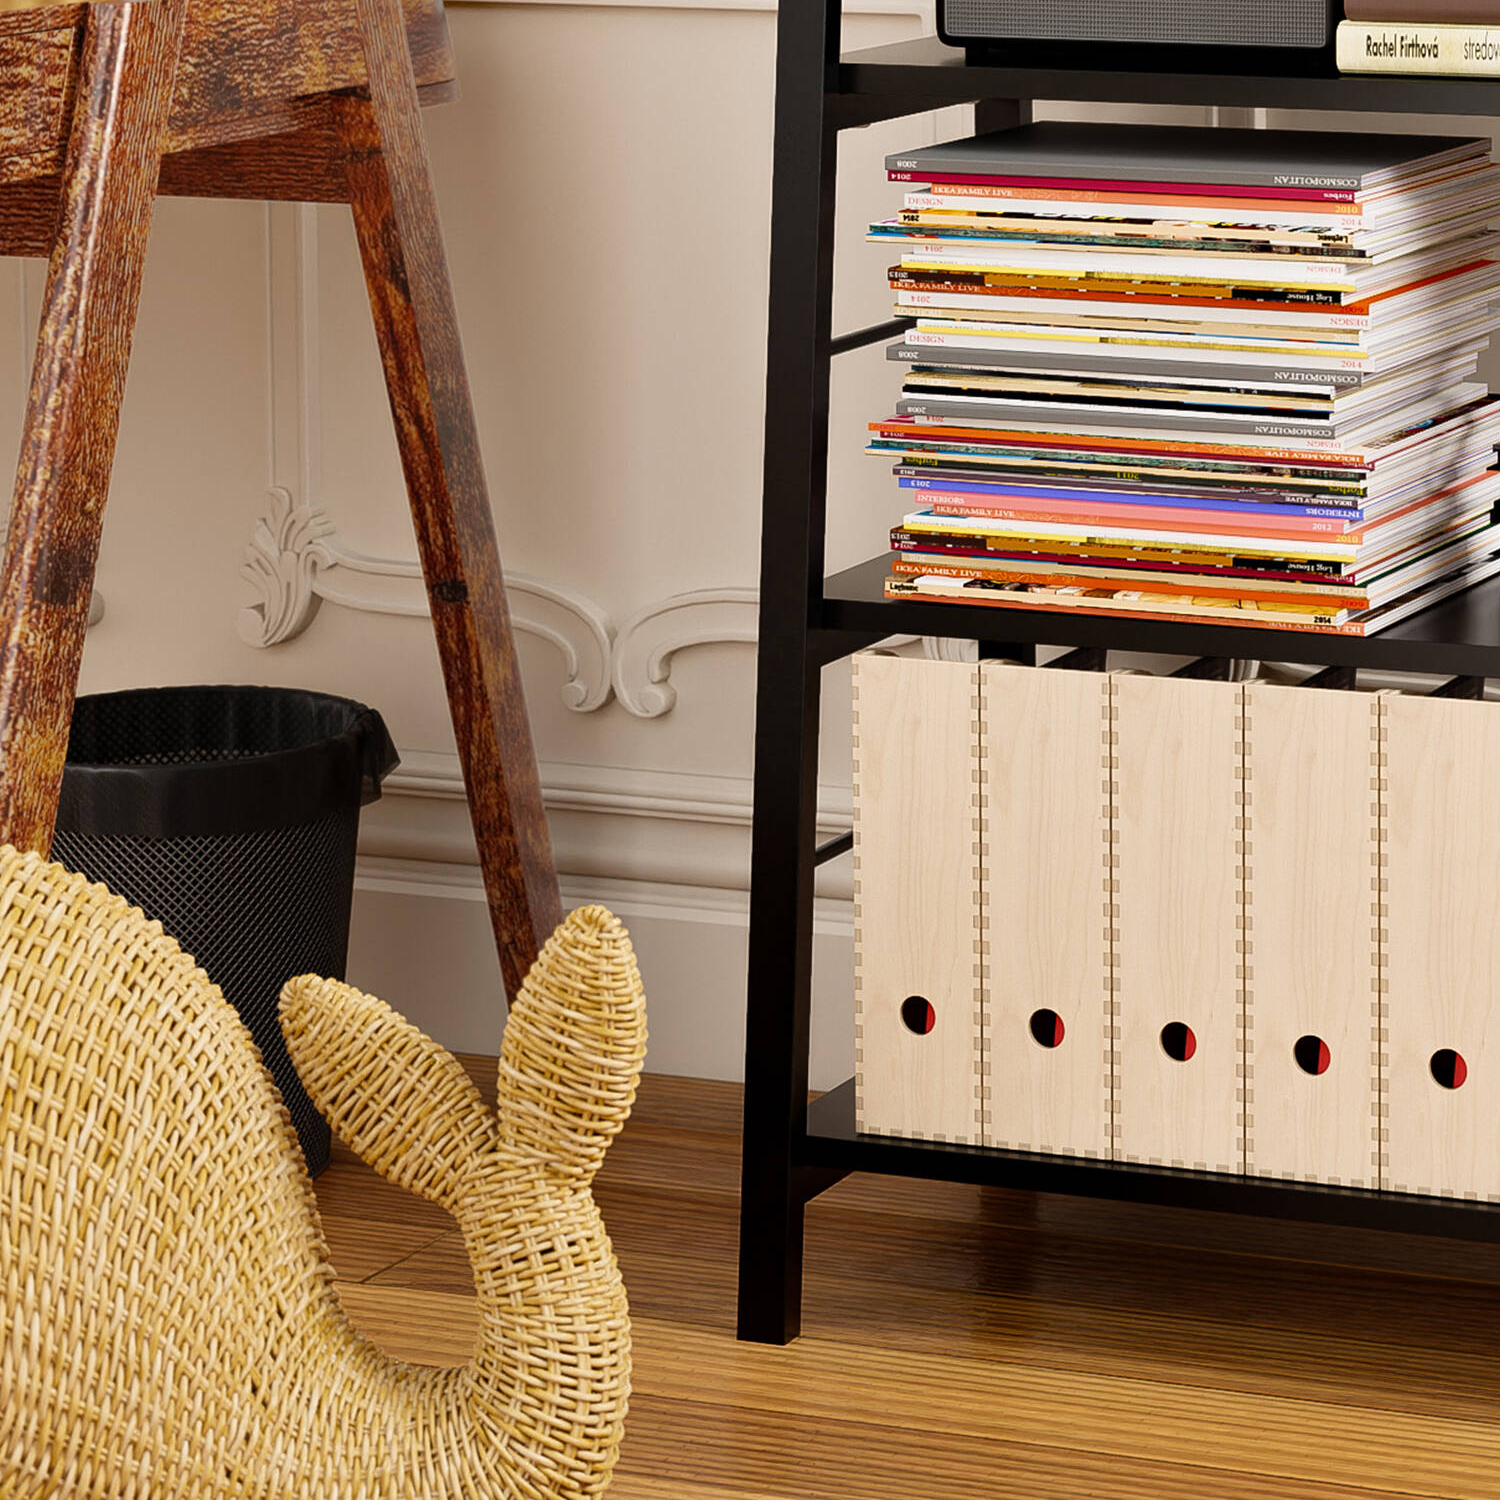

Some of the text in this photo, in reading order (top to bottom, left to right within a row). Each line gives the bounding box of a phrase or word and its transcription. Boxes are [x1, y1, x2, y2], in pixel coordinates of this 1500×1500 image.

[1366, 34, 1438, 59] Rachel Firthová
[896, 160, 918, 169] 2008
[891, 173, 912, 181] 2014
[1274, 176, 1358, 187] COSMOPOLITAN
[934, 186, 1013, 197] IKEA FAMILY LIVE
[1323, 192, 1354, 201] Forbes
[908, 197, 944, 206] DESIGN
[1335, 205, 1358, 214] 2010
[1341, 218, 1362, 226] 2014
[1307, 265, 1342, 273] DESIGN
[894, 281, 981, 292] IKEA FAMILY LIVE
[911, 295, 931, 303] 2014
[1286, 293, 1333, 302] Log House
[1330, 317, 1369, 327] DESIGN
[909, 335, 945, 343] DESIGN
[898, 351, 919, 359] 2008
[1341, 360, 1362, 369] 2014
[1274, 372, 1358, 383] COSMOPOLITAN
[907, 406, 927, 414] 2008
[1255, 426, 1332, 437] COSMOPOLITAN
[1307, 441, 1342, 449] DESIGN
[1328, 486, 1364, 496] Forbes
[917, 494, 965, 504] INTERIORS
[936, 506, 1014, 517] IKEA FAMILY LIVE
[1305, 508, 1360, 518] INTERIORS
[1335, 535, 1359, 543] 2010
[896, 565, 982, 578] IKEA FAMILY LIVE
[1316, 564, 1333, 573] Log
[1323, 574, 1354, 583] Forbes
[1313, 616, 1332, 624] 2014
